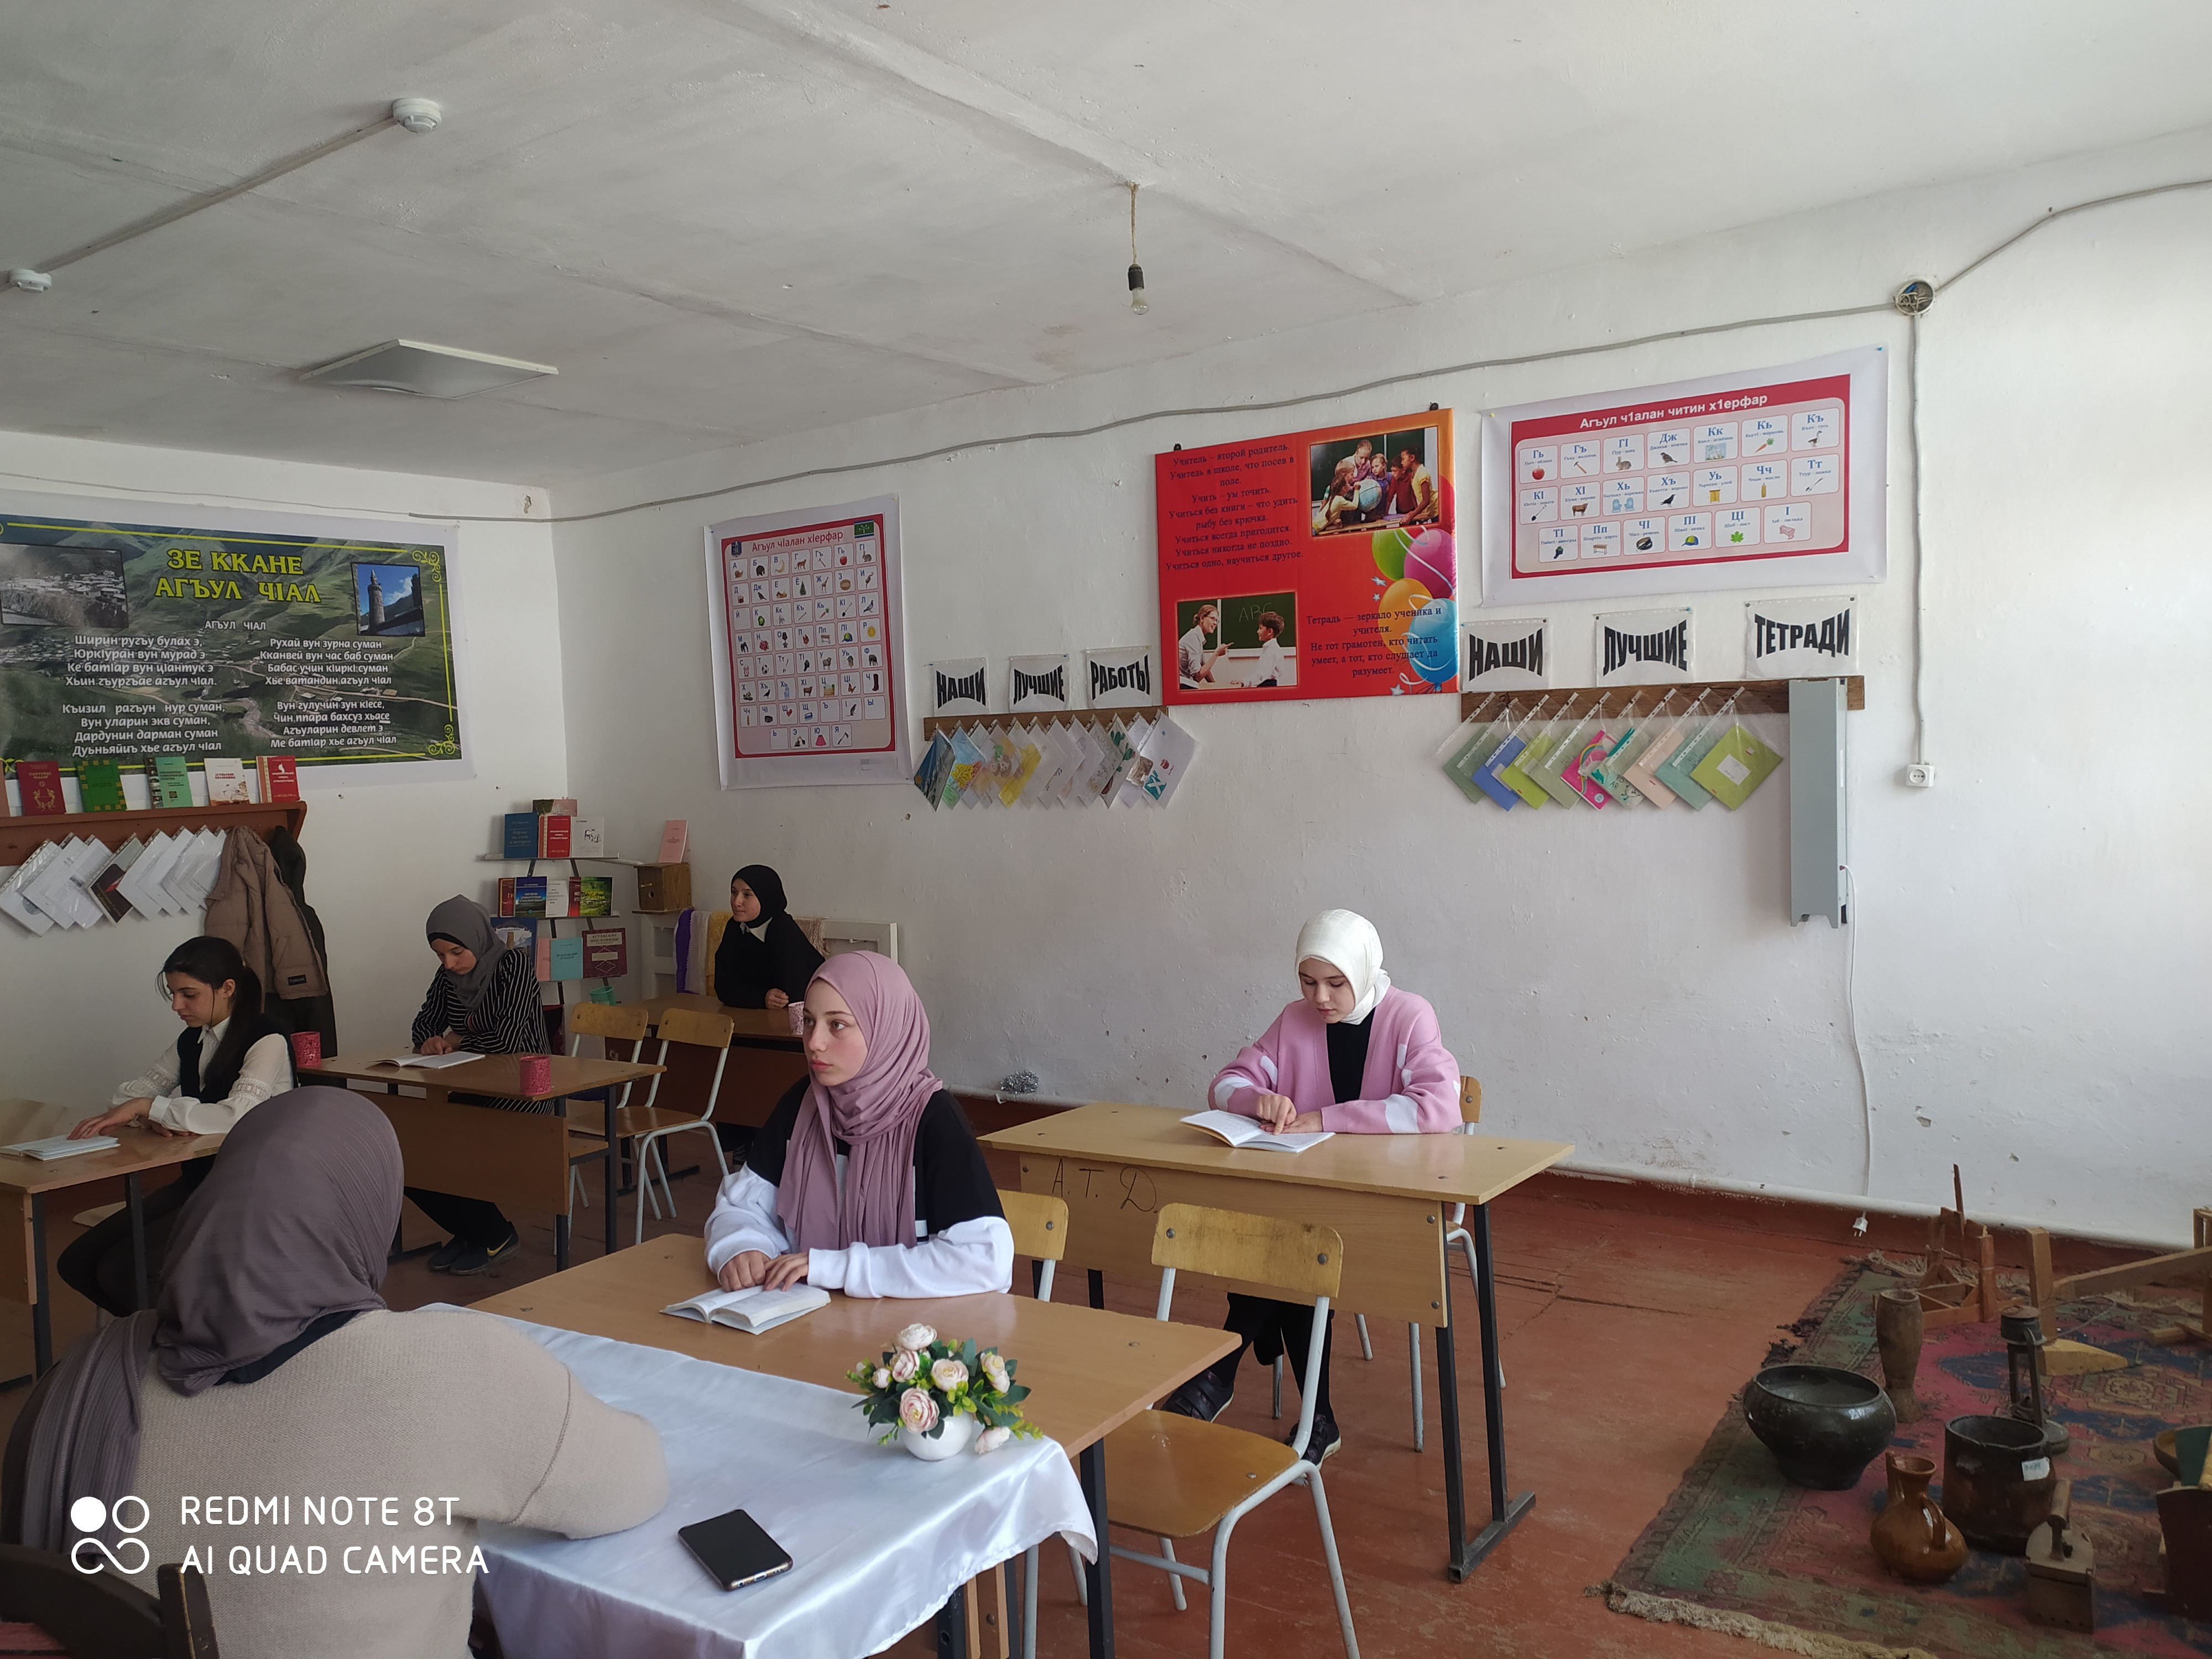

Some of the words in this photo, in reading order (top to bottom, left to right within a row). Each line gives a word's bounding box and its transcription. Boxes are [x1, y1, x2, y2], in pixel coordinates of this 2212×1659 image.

[1580, 416, 1617, 429] Агъул
[1668, 403, 1705, 416] читин
[1807, 414, 1824, 424] Къ
[1708, 427, 1723, 436] Кк
[1757, 421, 1772, 430] Кь
[1660, 433, 1677, 444] Дж
[1533, 450, 1544, 458] Гь
[1574, 444, 1587, 453] Гъ
[1173, 456, 1207, 466] Учитель
[1217, 448, 1245, 461] второй
[1249, 444, 1290, 457] родитель.
[1170, 469, 1203, 479] Учитель
[1213, 465, 1242, 474] школе,
[1261, 458, 1286, 467] посев
[1220, 478, 1241, 486] поле.
[1169, 509, 1202, 519] Учиться
[1206, 507, 1218, 515] без
[1221, 503, 1245, 512] книги
[1273, 498, 1298, 508] удить
[1196, 519, 1216, 530] рыбу
[1235, 514, 1269, 525] крючка.
[1175, 533, 1208, 544] Учиться
[1212, 530, 1238, 540] всегда
[1240, 525, 1292, 537] пригодится.
[752, 541, 775, 552] Агъул
[167, 549, 202, 570] ЗЕ
[211, 551, 304, 575] ККАНЕ
[1166, 561, 1199, 571] Учиться
[1202, 559, 1224, 567] одно,
[1227, 555, 1269, 566] научиться
[1272, 550, 1303, 561] другое.
[155, 577, 242, 599] АГЪУЛ
[1306, 616, 1341, 625] Тетрадь
[1357, 611, 1391, 622] зеркало
[1394, 608, 1432, 620] ученика
[205, 620, 236, 630] АГЪУЛ
[1353, 625, 1391, 637] учителя.
[75, 635, 118, 646] Ширин
[121, 638, 154, 648] ругъу
[157, 636, 190, 648] булах
[194, 638, 202, 647] э,
[270, 638, 300, 650] Рухай
[303, 639, 320, 650] вун
[322, 640, 350, 650] зурна
[352, 640, 382, 650] суман
[1311, 643, 1322, 651] Не
[1342, 640, 1385, 651] грамотен,
[1407, 635, 1438, 645] читать
[1469, 627, 1543, 682] НАШИ
[1603, 618, 1688, 676] ЛУЧШИЕ
[1754, 607, 1850, 659] ТЕТРАДИ
[138, 651, 158, 660] вун
[161, 649, 197, 661] мурад
[199, 651, 206, 659] э
[260, 651, 302, 660] Кканвей
[306, 652, 322, 662] вун
[325, 652, 341, 660] час
[344, 651, 361, 660] баб
[363, 653, 393, 662] суман
[1312, 657, 1338, 666] умеет,
[1386, 651, 1424, 662] слушает
[67, 663, 81, 672] Ке
[133, 664, 153, 674] вун
[268, 664, 298, 672] Бабас
[300, 665, 324, 675] учин
[358, 665, 388, 674] суман
[1352, 666, 1394, 678] разумеет.
[65, 676, 97, 686] Хьин
[98, 679, 152, 688] гъургъае
[155, 678, 188, 688] агъул
[265, 676, 283, 685] Хье
[285, 675, 338, 685] ватандин
[340, 676, 369, 687] агъул
[936, 666, 986, 709] НАШИ
[1013, 664, 1065, 706] ЛУЧШИЕ
[1090, 654, 1150, 701] РАБОТЫ
[62, 705, 106, 714] Къизил
[115, 705, 155, 715] рагъун
[165, 703, 185, 714] нур
[188, 703, 225, 713] суман,
[277, 701, 295, 712] Вун
[298, 701, 338, 712] гулучин
[341, 701, 357, 711] зун
[81, 718, 101, 729] Вун
[105, 718, 148, 729] уларин
[151, 717, 170, 726] экв
[173, 716, 211, 728] суман,
[75, 730, 133, 743] Дардунин
[137, 729, 181, 741] дарман
[184, 729, 218, 739] суман
[283, 726, 338, 737] Агъуларин
[341, 724, 375, 733] девлет
[270, 739, 285, 748] Ме
[329, 738, 345, 746] хье
[347, 737, 374, 747] агъул
